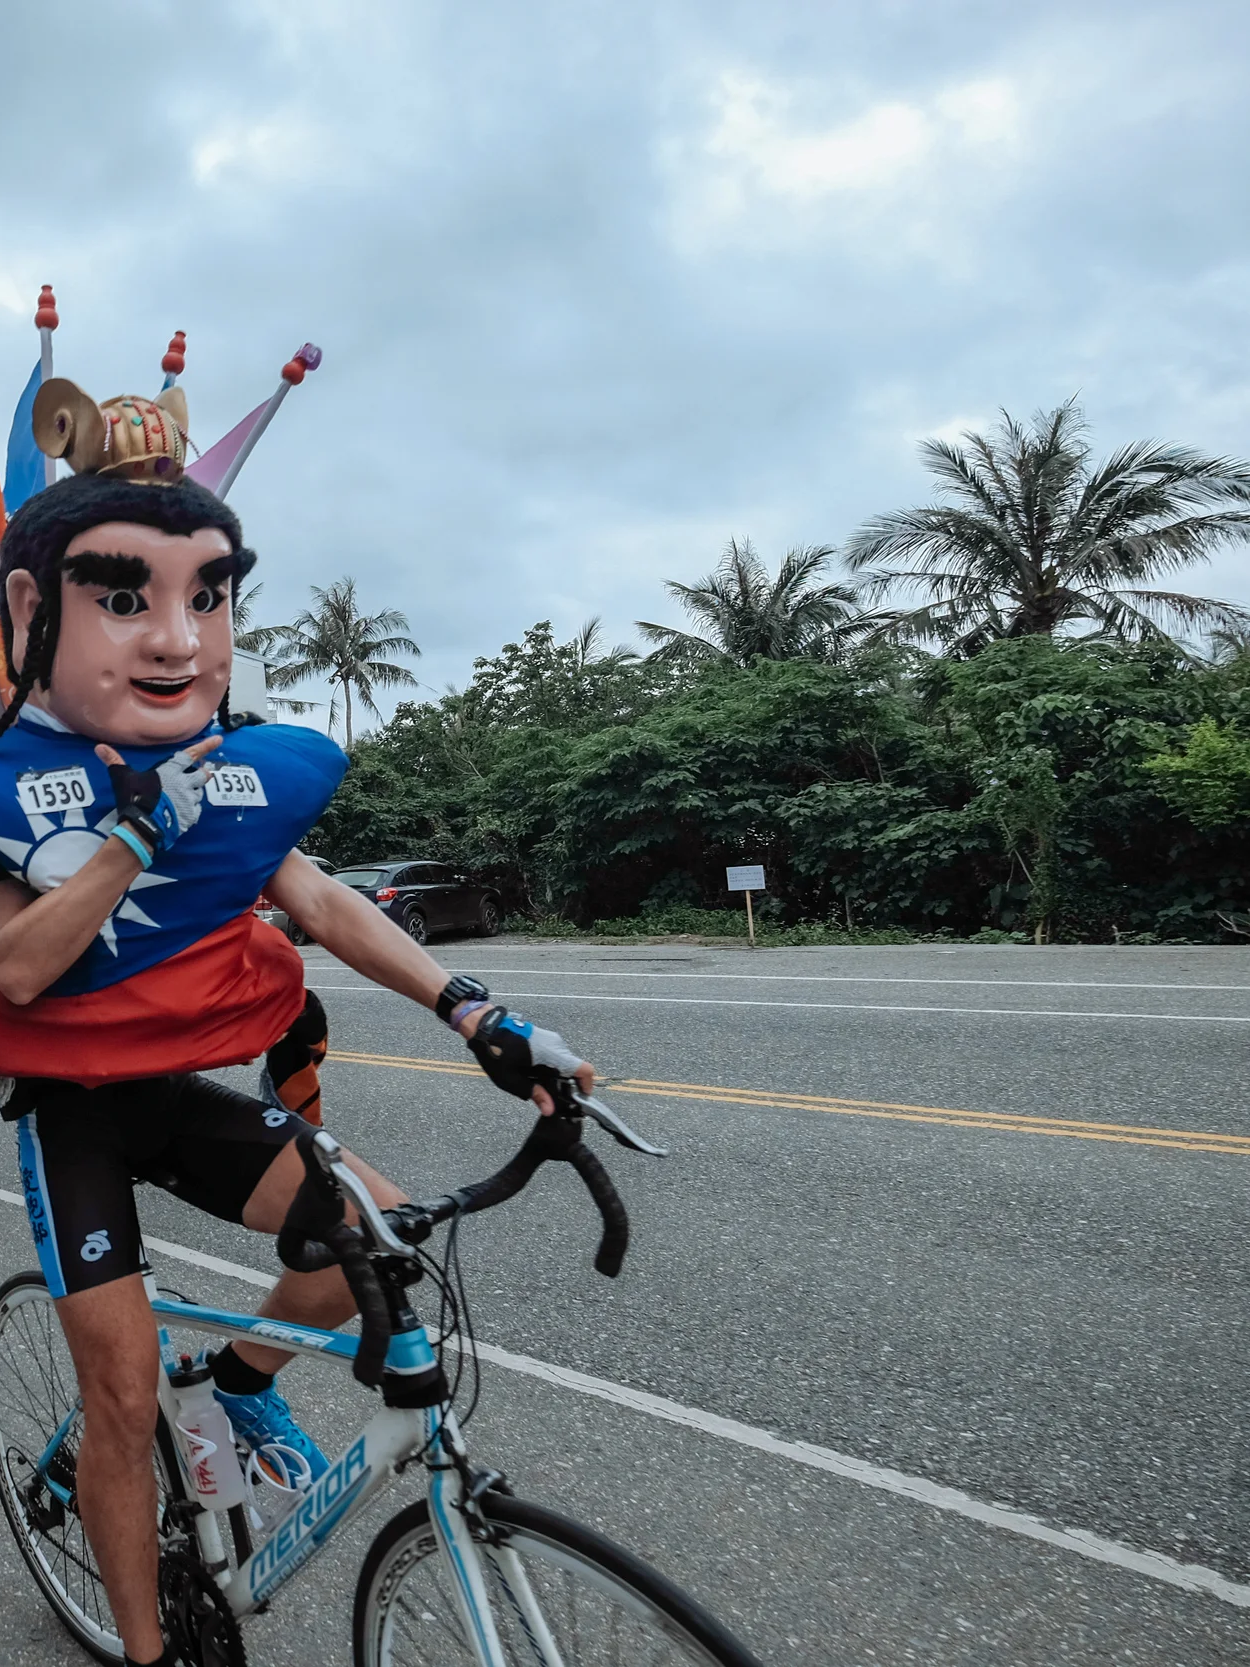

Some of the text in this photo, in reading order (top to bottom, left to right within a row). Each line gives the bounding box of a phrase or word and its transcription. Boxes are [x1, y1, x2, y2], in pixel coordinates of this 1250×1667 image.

[28, 780, 85, 808] 1530
[211, 773, 256, 793] 1530
[250, 1435, 366, 1589] MERIDA
